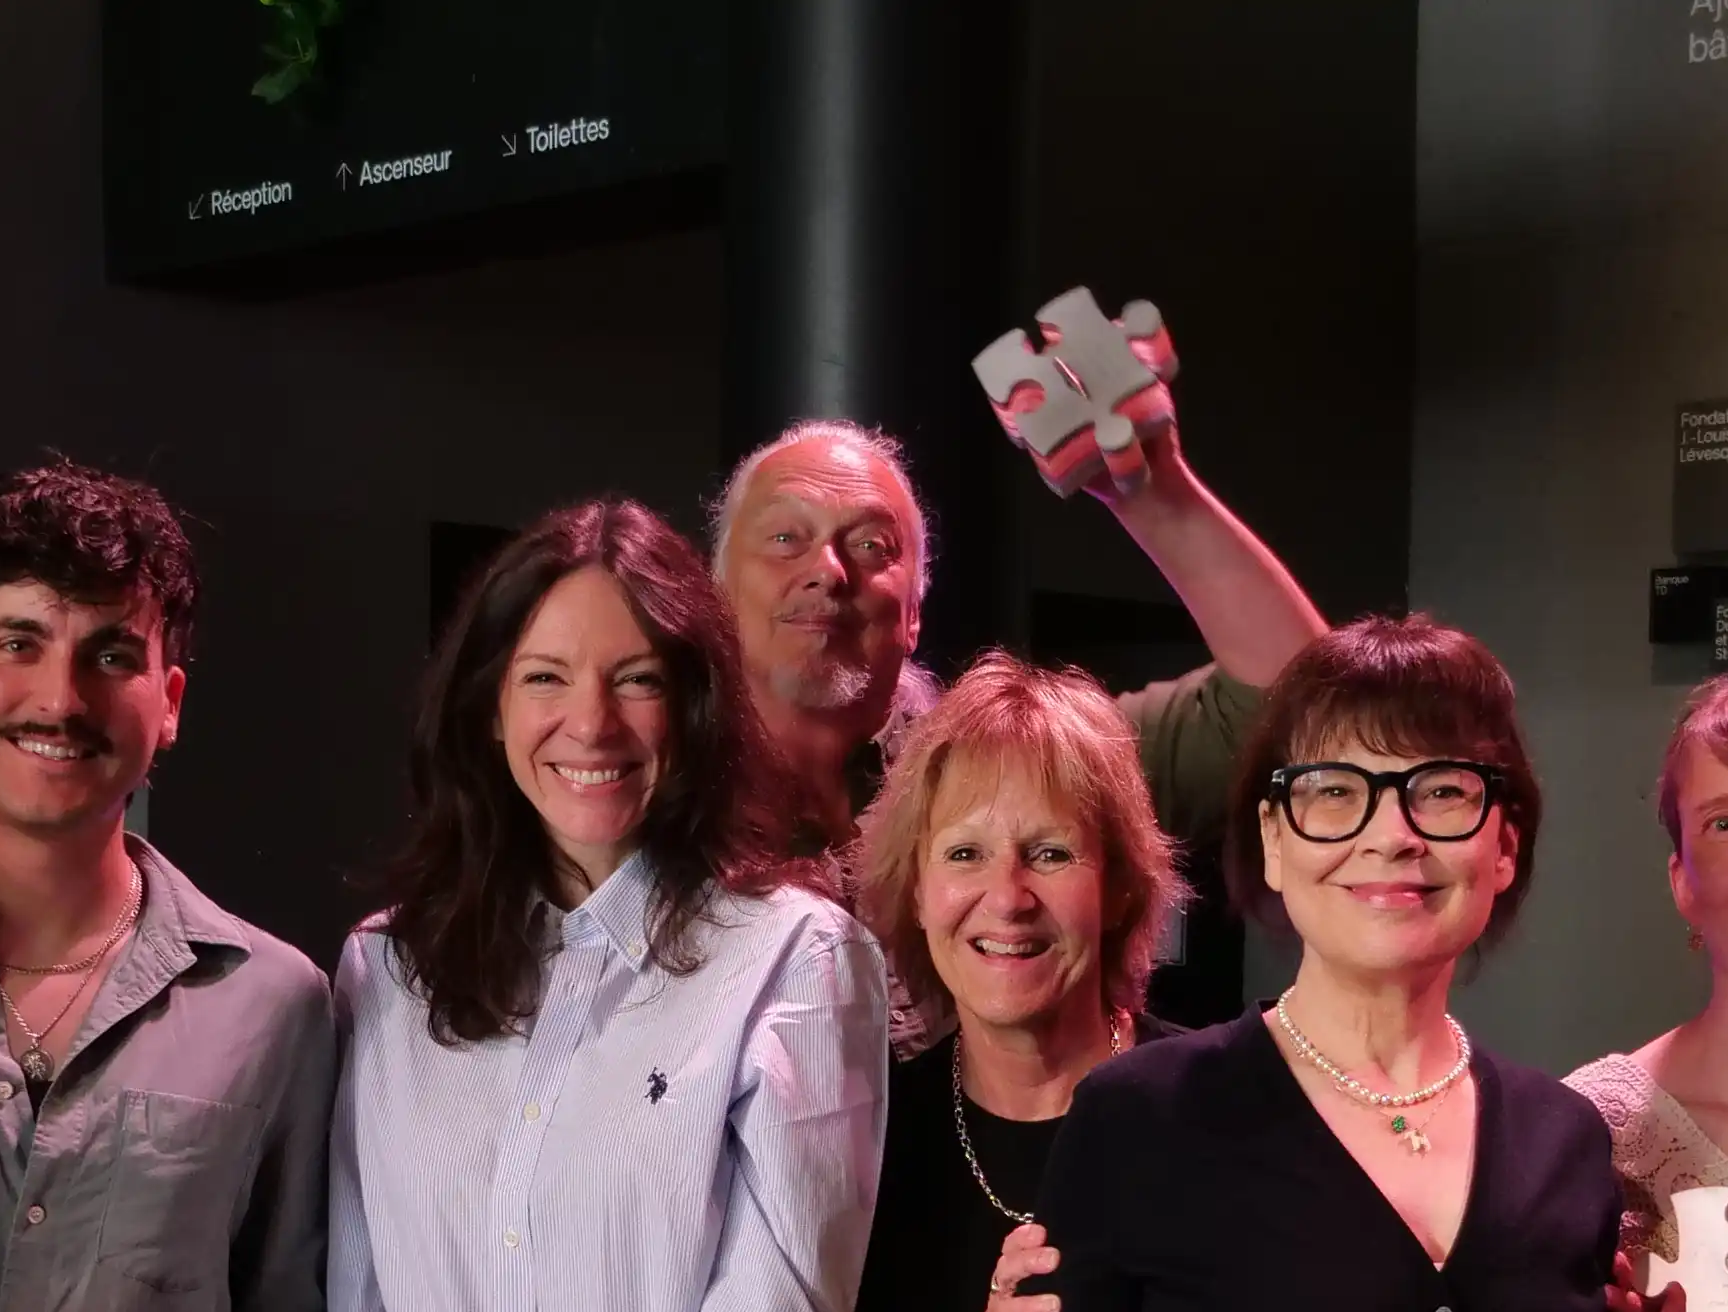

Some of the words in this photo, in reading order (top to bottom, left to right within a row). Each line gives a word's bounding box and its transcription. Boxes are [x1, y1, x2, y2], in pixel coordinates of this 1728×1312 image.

[526, 117, 610, 153] Toilettes
[359, 149, 453, 186] Ascenseur
[211, 181, 292, 215] Réception
[1715, 635, 1727, 646] et
